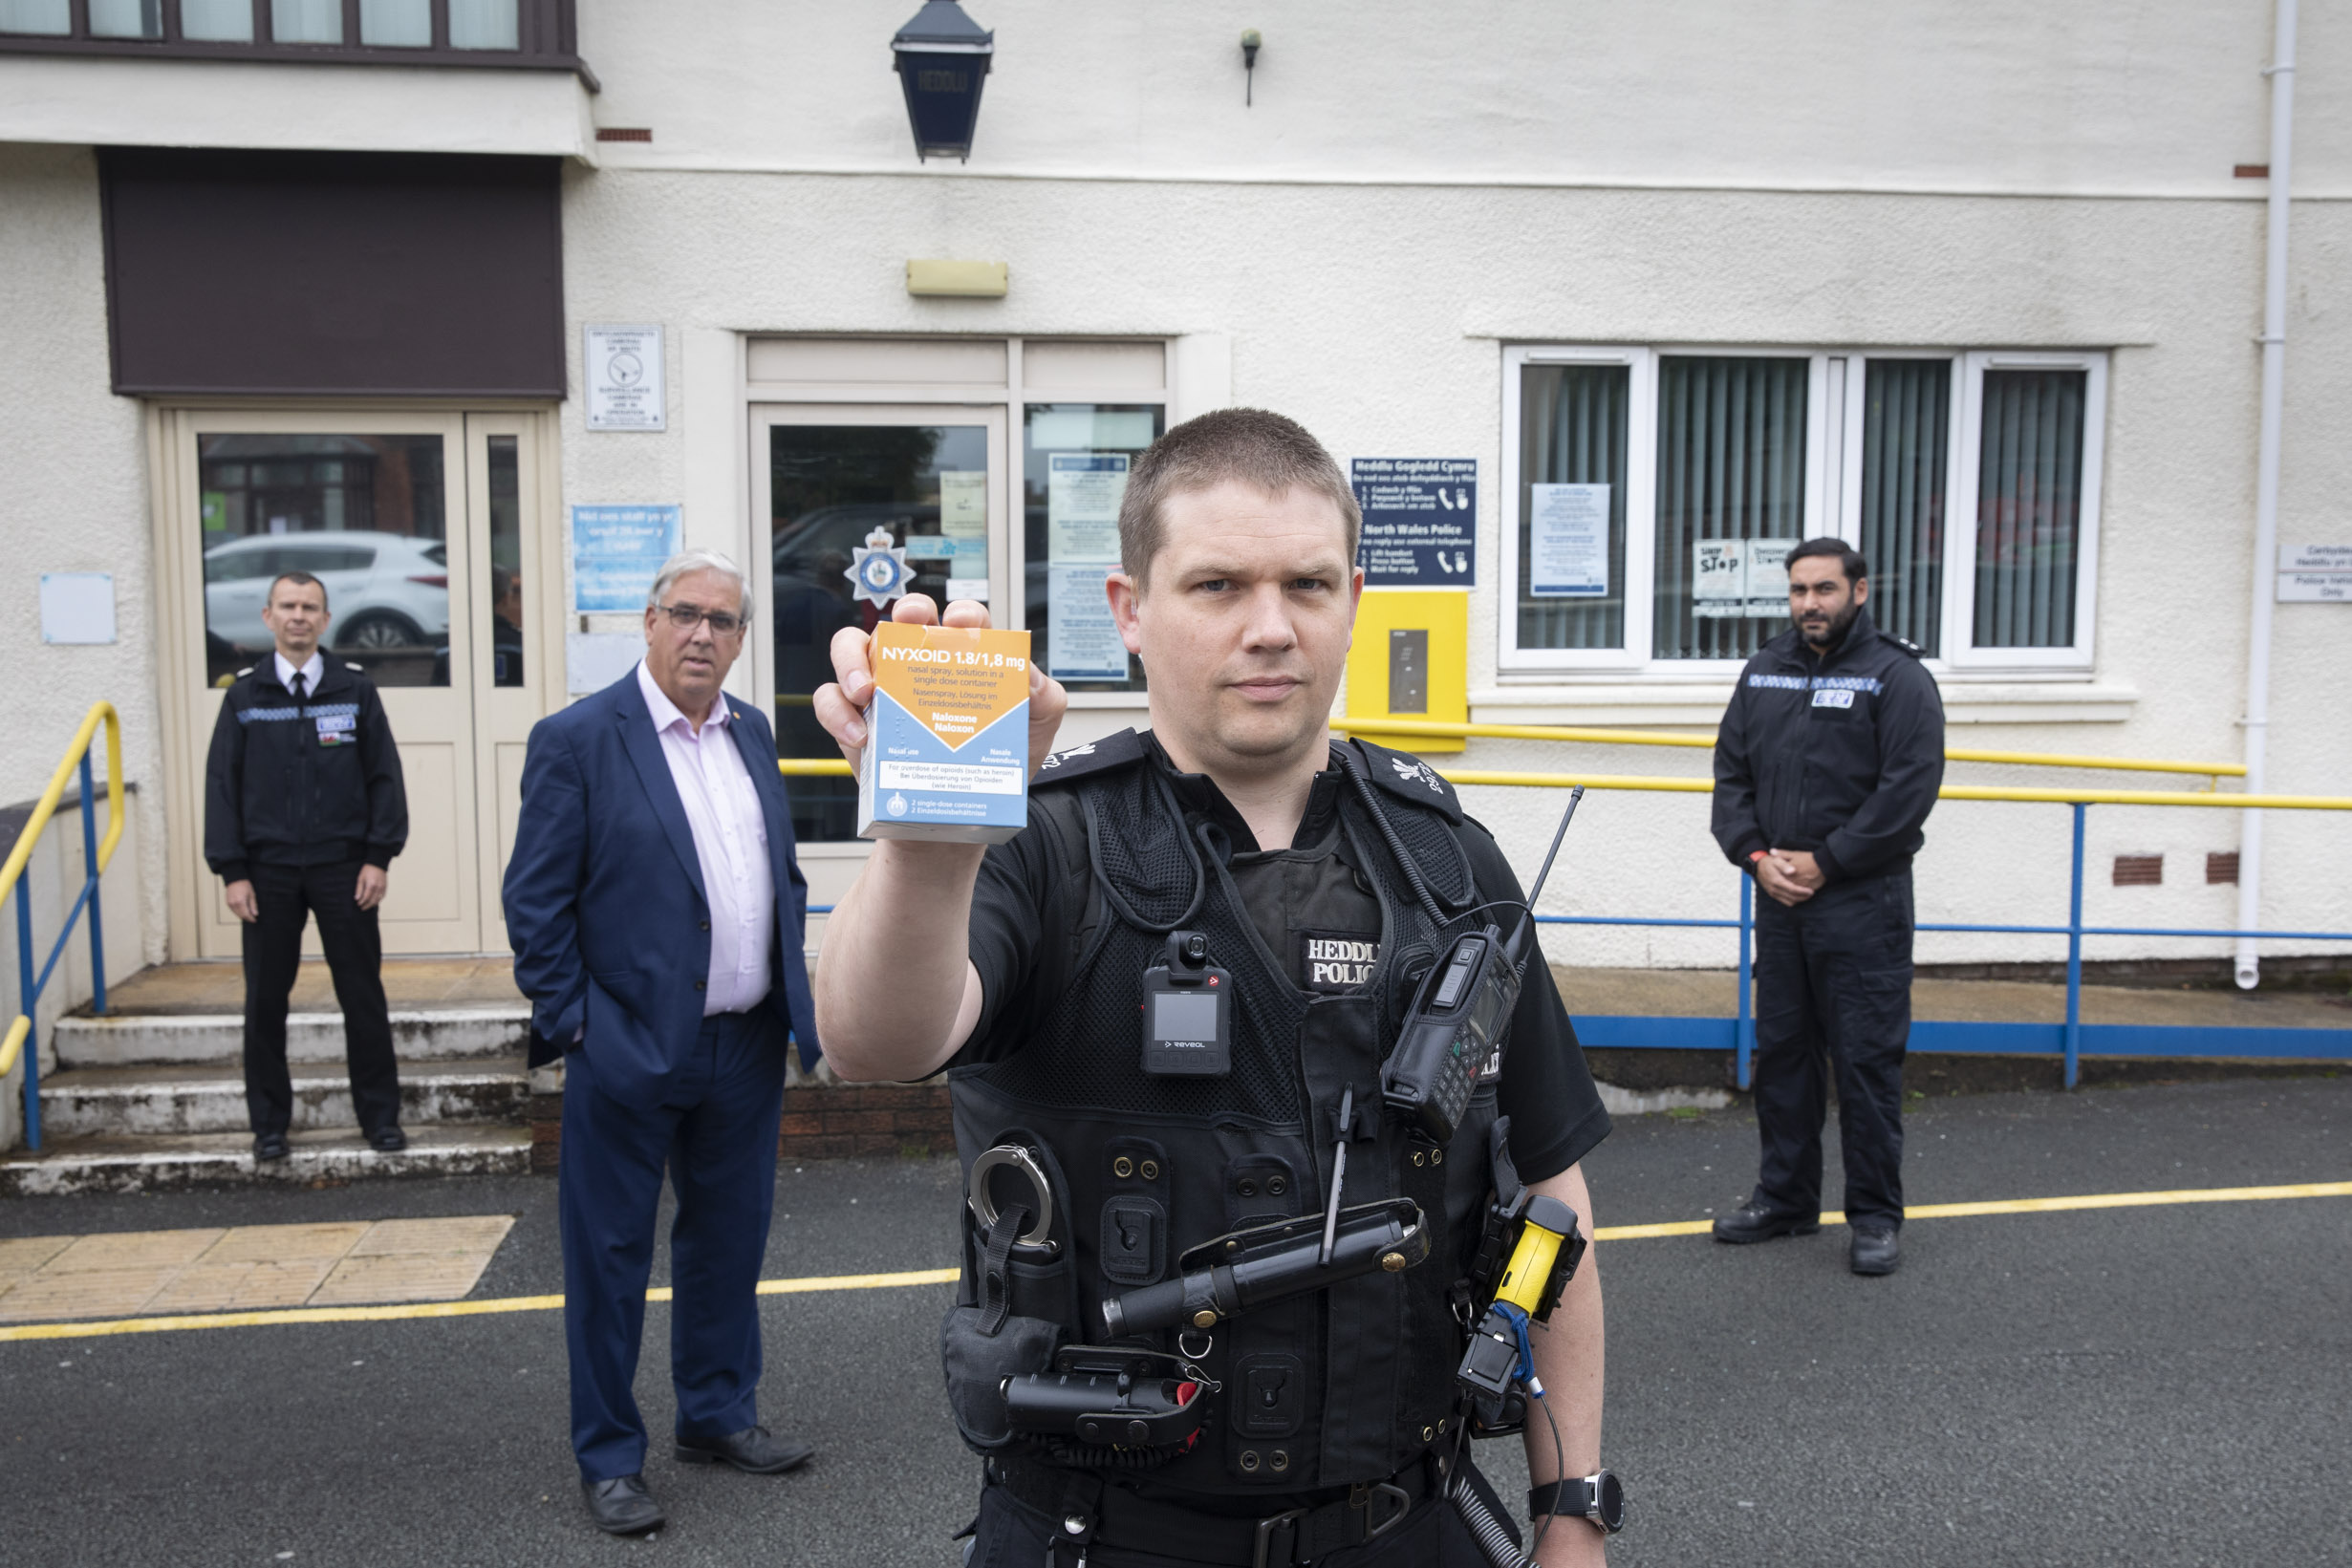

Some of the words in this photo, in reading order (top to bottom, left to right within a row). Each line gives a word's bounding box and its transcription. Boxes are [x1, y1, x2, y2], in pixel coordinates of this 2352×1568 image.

[1365, 524, 1395, 535] North
[1397, 524, 1429, 535] Wales
[1431, 524, 1462, 535] Police
[882, 647, 951, 663] NYXOID
[955, 651, 1003, 668] 1.8/1,8
[1005, 656, 1025, 672] mg
[908, 665, 929, 675] nasal
[956, 668, 988, 677] solution
[989, 670, 997, 678] in
[913, 676, 938, 685] single
[939, 677, 959, 685] dose
[960, 678, 997, 688] container
[932, 712, 978, 723] Naloxone
[934, 722, 975, 733] Naloxon
[888, 746, 906, 756] Nasal
[981, 756, 1020, 765] Anwendung
[912, 772, 959, 782] Überdosierung
[1307, 939, 1381, 962] HEDDL
[1313, 962, 1374, 984] POLIC
